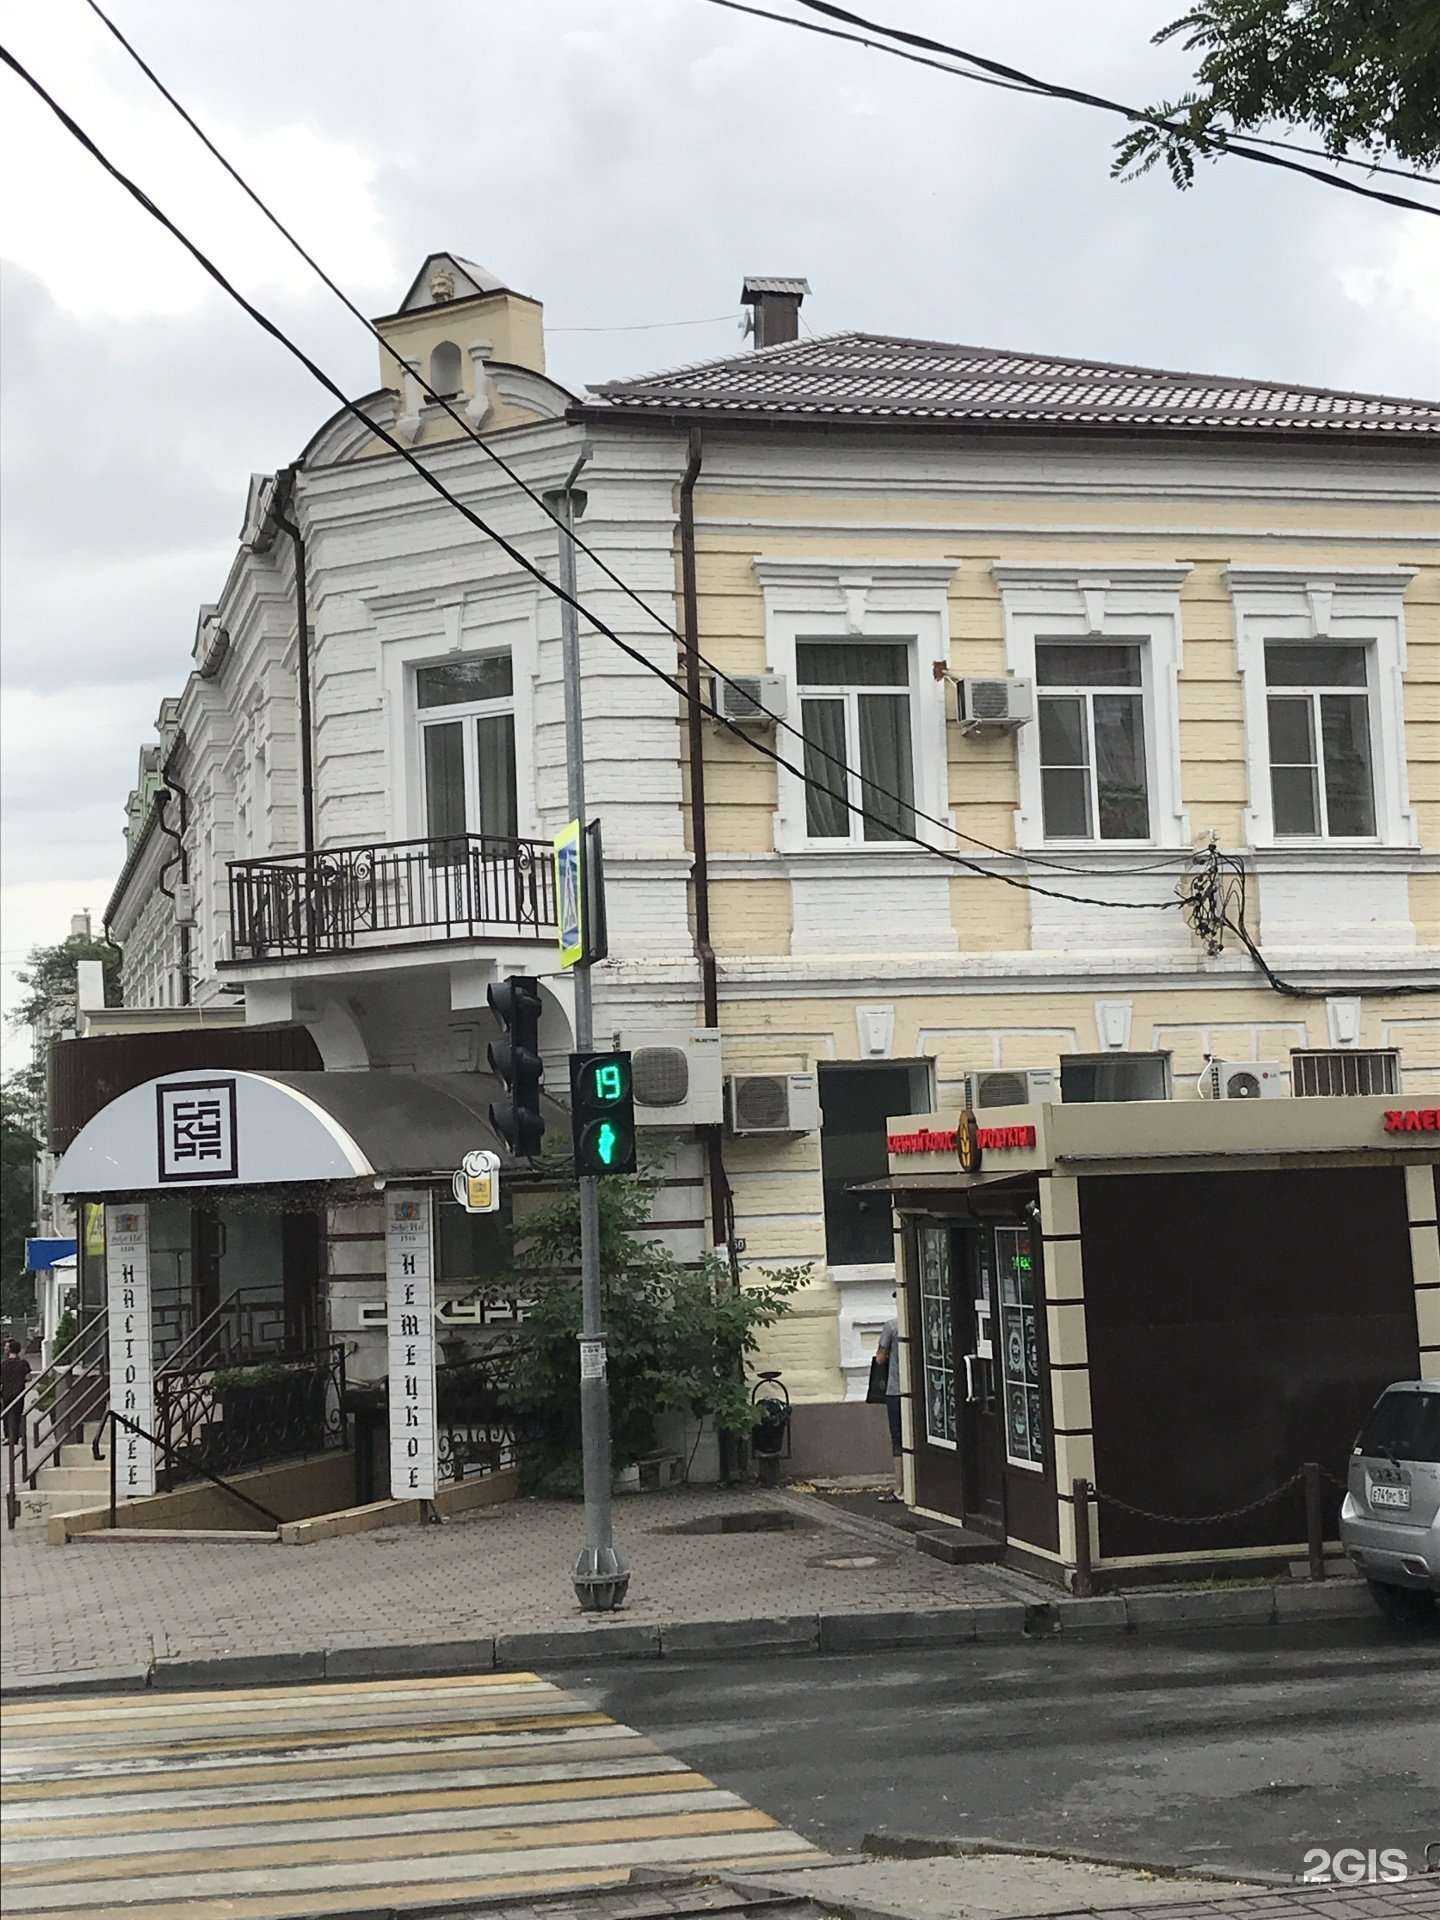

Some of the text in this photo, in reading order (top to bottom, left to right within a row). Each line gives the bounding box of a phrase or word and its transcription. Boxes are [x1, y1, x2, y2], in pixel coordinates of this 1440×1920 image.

[594, 1066, 621, 1099] 19
[1384, 1109, 1440, 1132] ХЛЕ
[121, 1263, 141, 1486] НАСТОЯЩЕЕ
[401, 1253, 420, 1489] НЕМЕЦКОЕ
